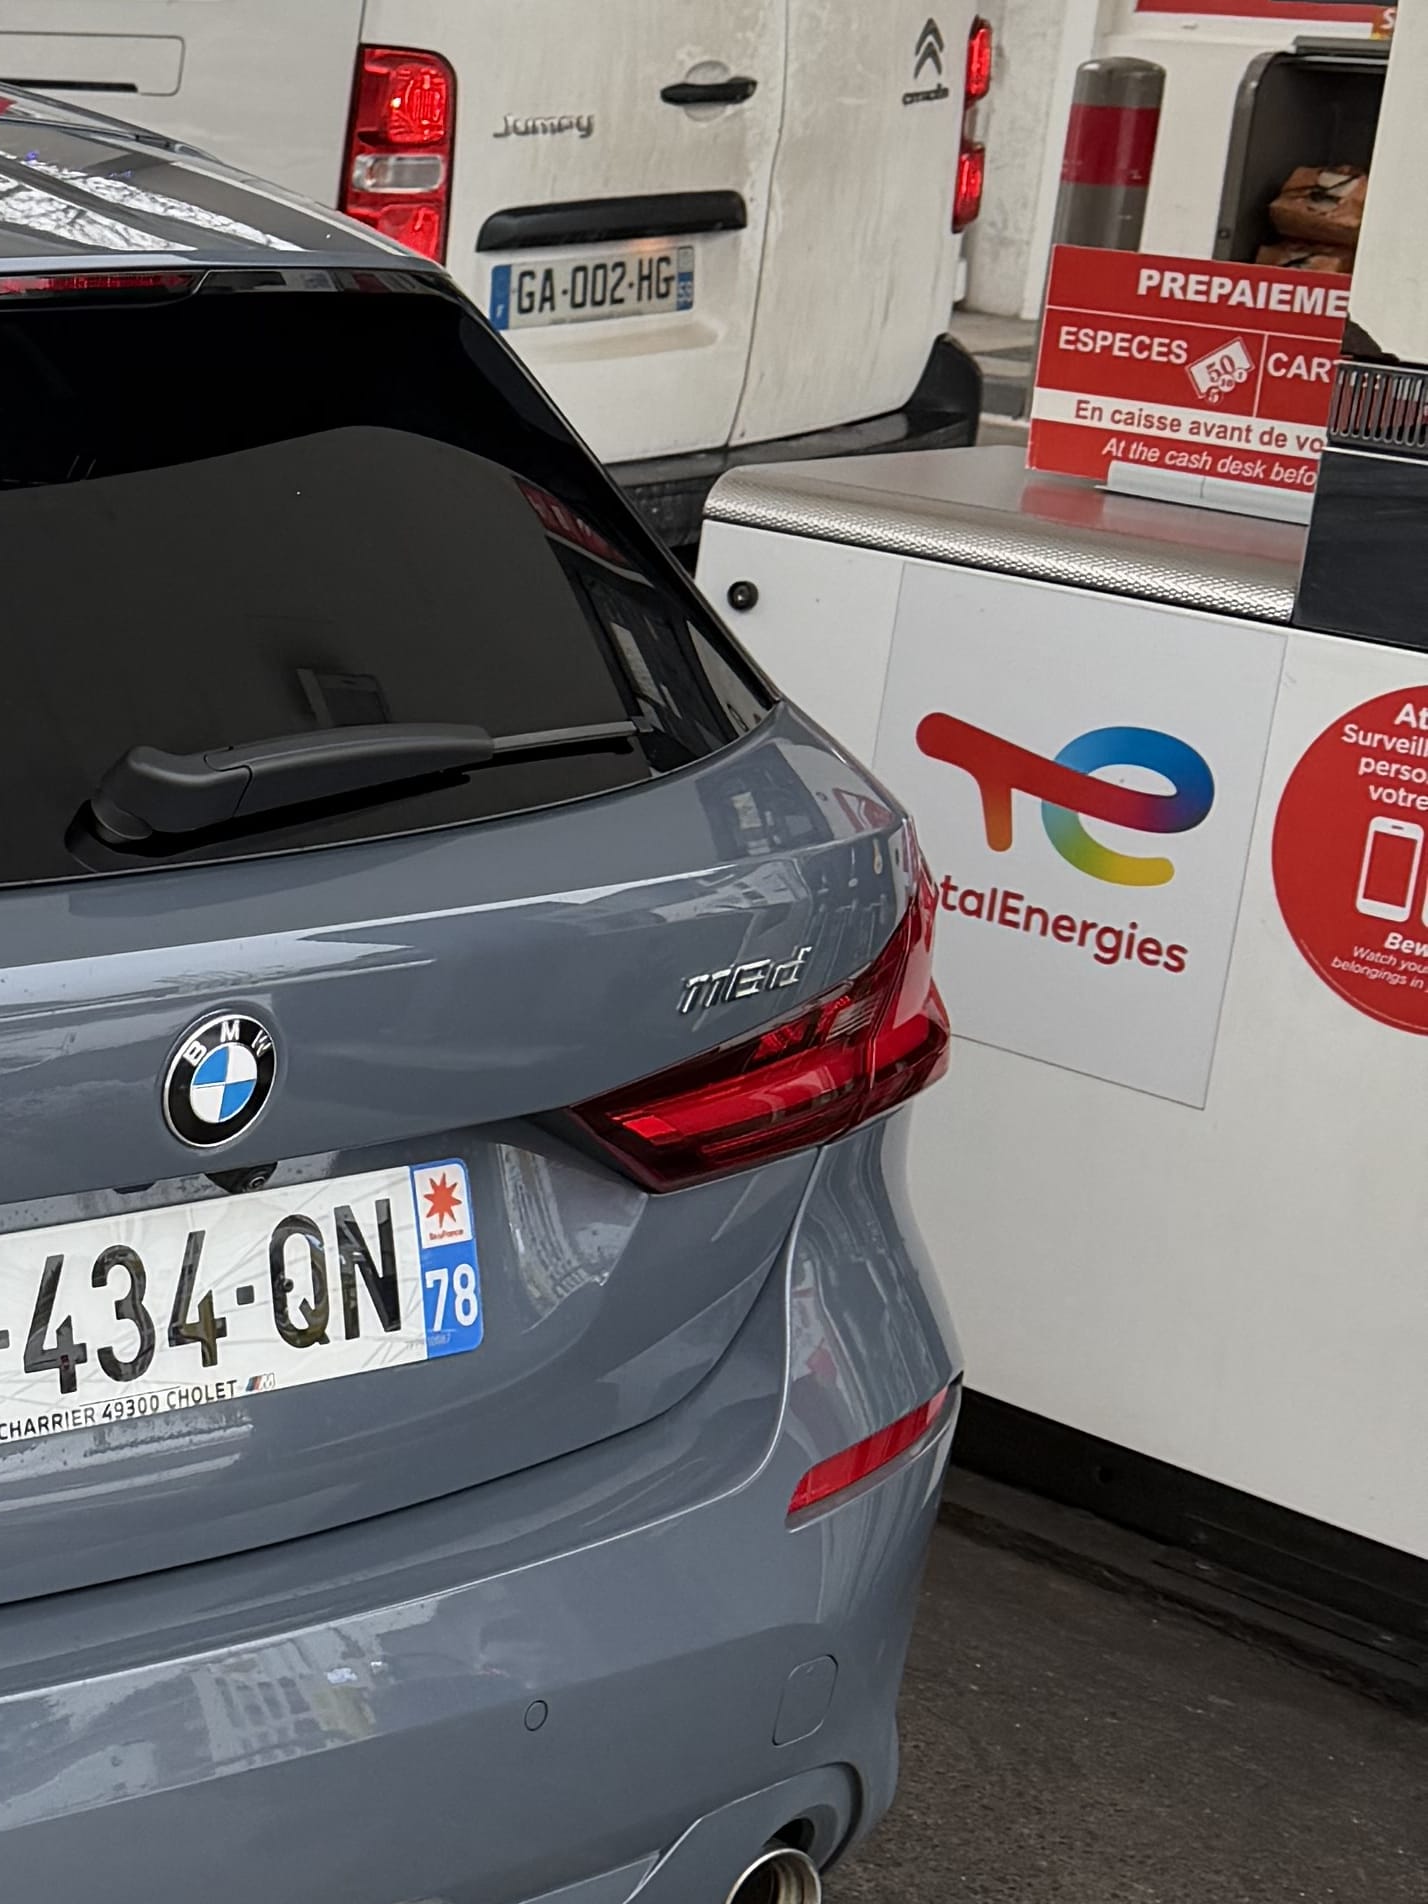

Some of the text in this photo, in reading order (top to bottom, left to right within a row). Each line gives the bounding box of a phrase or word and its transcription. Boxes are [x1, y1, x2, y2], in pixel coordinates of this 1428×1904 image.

[516, 254, 676, 316] GA-002-HG
[1136, 267, 1351, 319] PREPAIEME
[1057, 325, 1189, 366] ESPECES
[1267, 351, 1337, 384] CAR
[1074, 398, 1103, 422] En
[1110, 406, 1183, 434] caisse
[1188, 419, 1253, 445] avant
[1258, 425, 1289, 449] de
[1101, 437, 1318, 487] At the cash desk befo
[1357, 756, 1428, 785] perso
[1367, 783, 1428, 811] votre
[939, 873, 1190, 975] talEnergies
[1330, 956, 1425, 989] belongings in
[1351, 945, 1397, 966] Watch
[182, 1018, 273, 1068] BMW
[424, 1262, 479, 1334] 78
[100, 1393, 161, 1421] 49300
[166, 1379, 238, 1411] CHOLET
